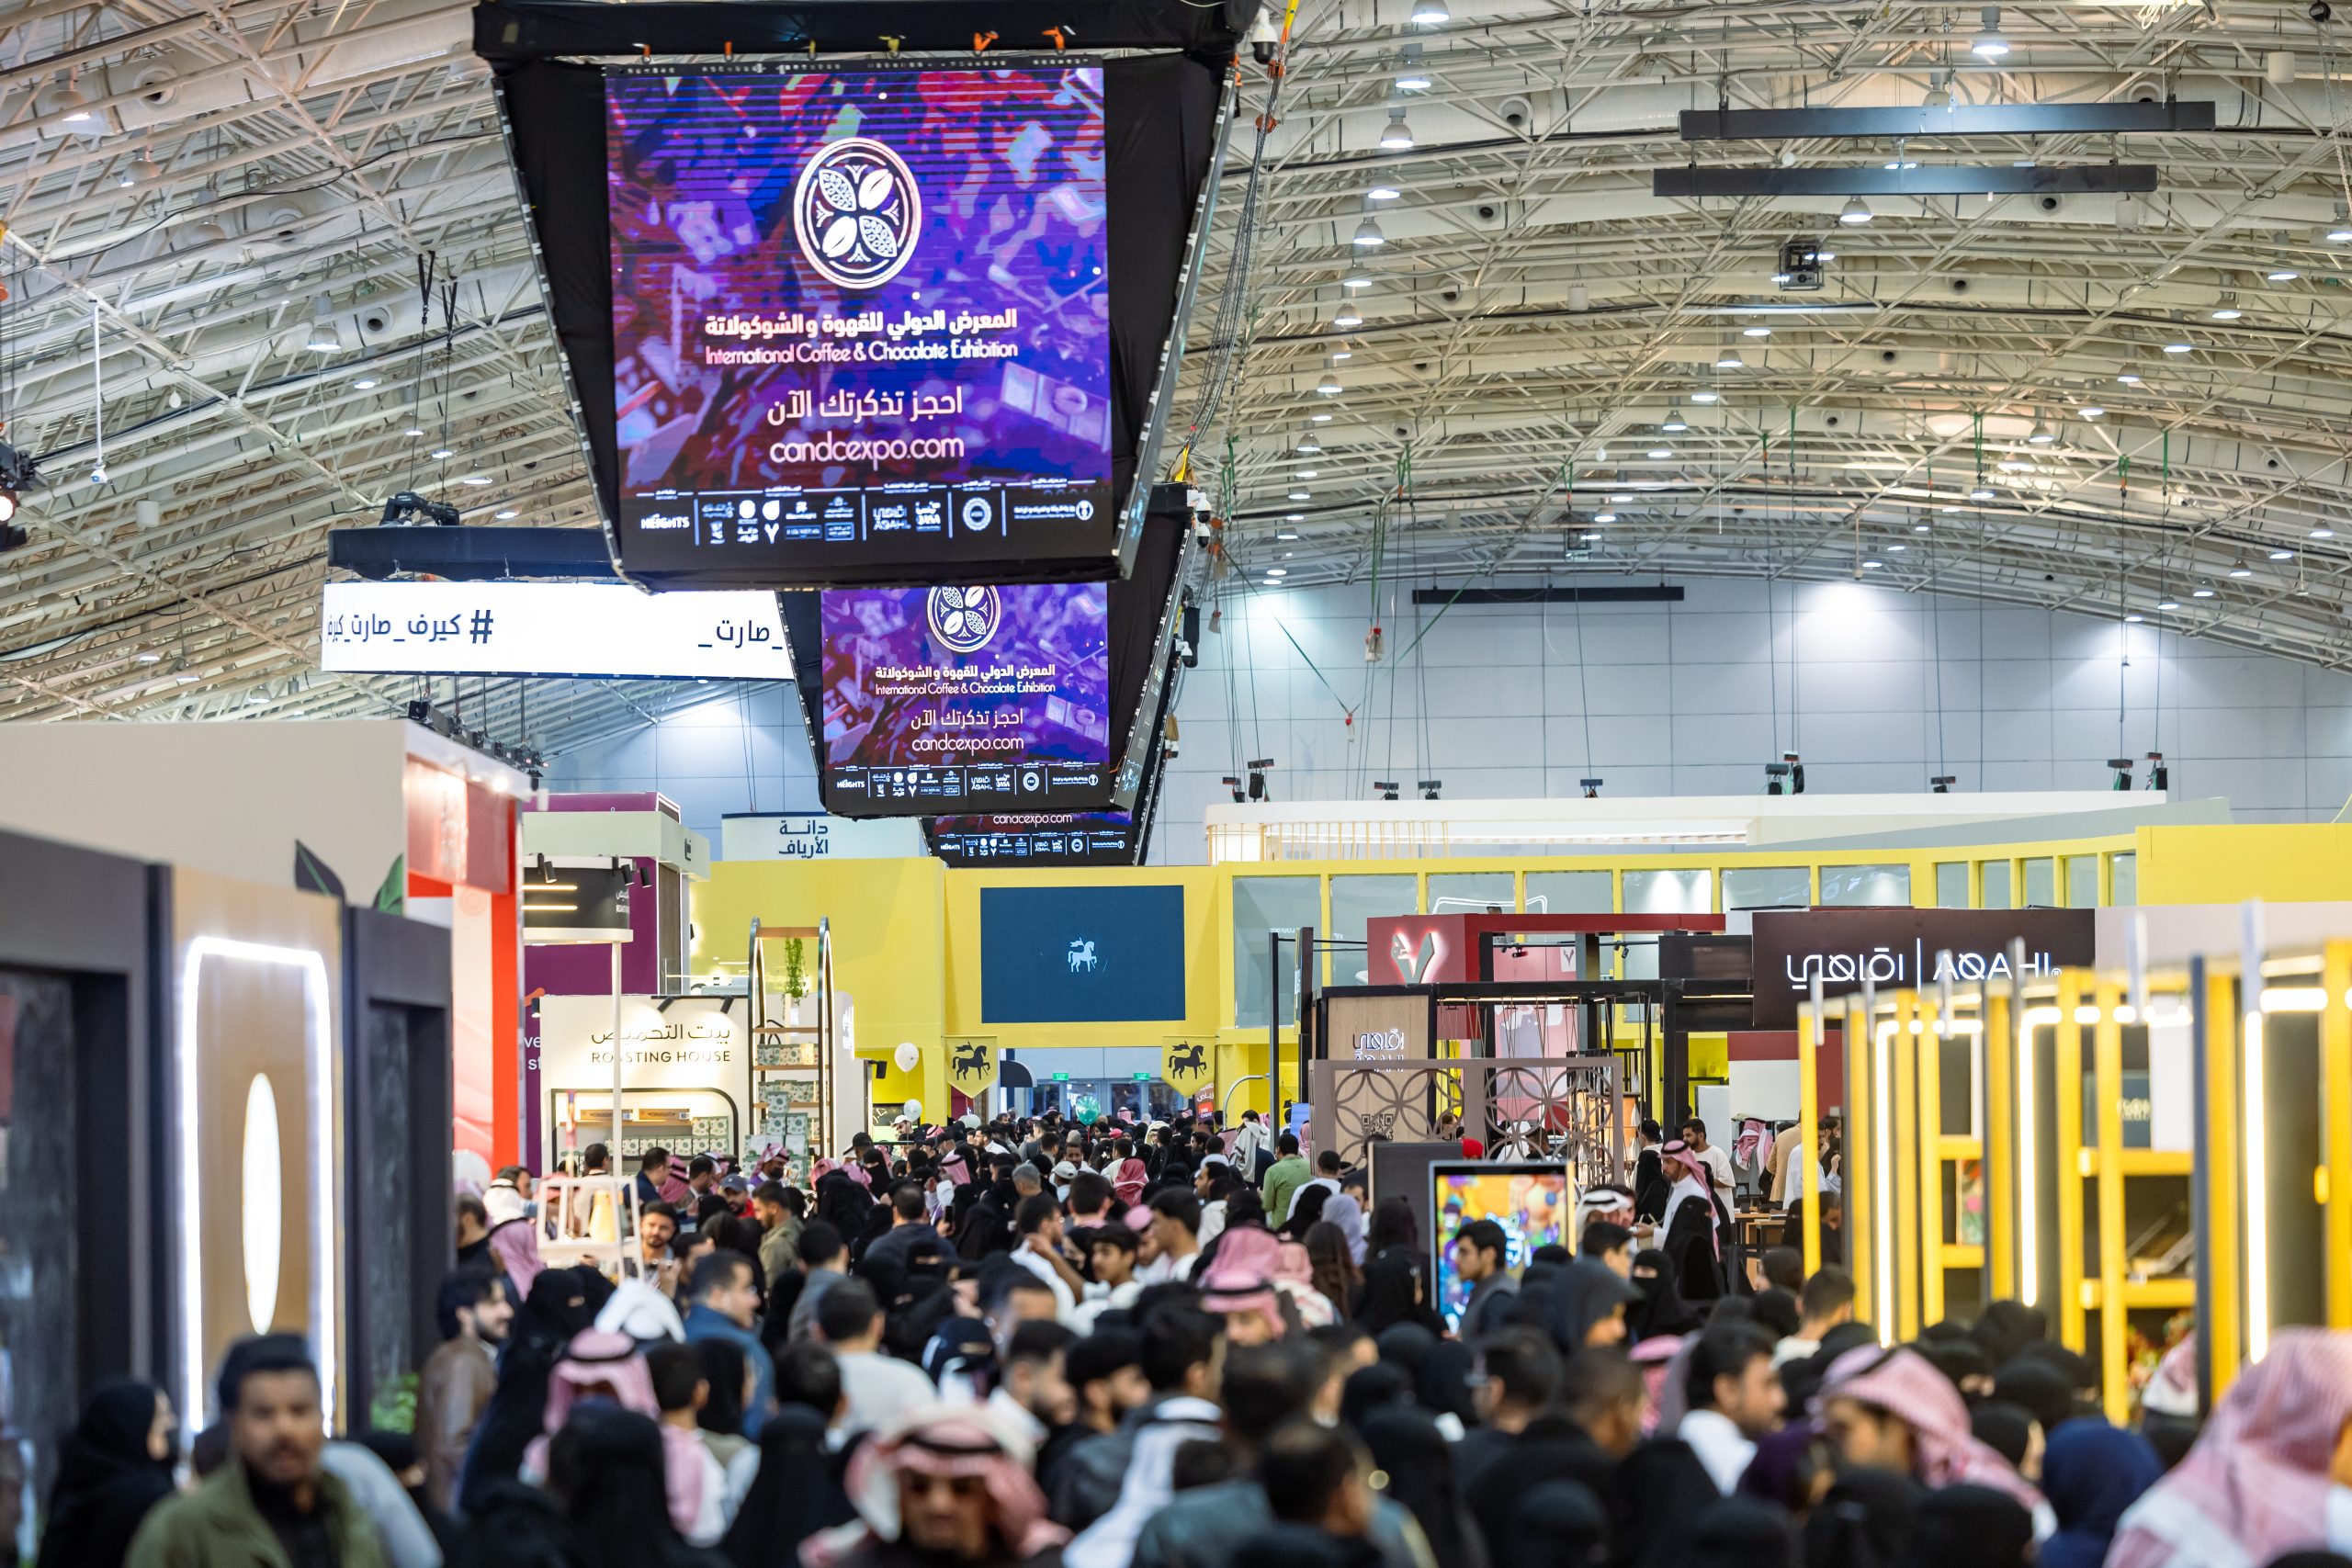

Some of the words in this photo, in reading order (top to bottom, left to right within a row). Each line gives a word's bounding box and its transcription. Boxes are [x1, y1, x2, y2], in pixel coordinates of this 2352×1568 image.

[705, 311, 803, 340] الشوكولاتة
[823, 312, 883, 337] للقهوة
[888, 310, 945, 341] الدولي
[950, 308, 1017, 332] المعرض
[706, 343, 795, 366] International
[797, 343, 851, 363] Coffee
[853, 343, 865, 361] &
[868, 340, 948, 363] Chocolate
[951, 339, 1018, 360] Exhibition
[767, 389, 811, 425] الآن
[820, 388, 905, 424] تذكرتك
[911, 386, 962, 422] احجز
[769, 432, 965, 471] candcexpo.com
[641, 513, 689, 529] HEIGHTS
[876, 666, 932, 681] الشوكولاتة
[943, 665, 978, 679] للقهوة
[980, 665, 1013, 682] الدولي
[1016, 664, 1056, 678] المعرض
[876, 682, 926, 695] International
[928, 682, 958, 694] Coffee
[960, 682, 967, 694] &
[969, 681, 1015, 694] Chocolate
[1016, 681, 1056, 693] Exhibition
[910, 710, 936, 729] الآن
[941, 709, 989, 729] تذكرتك
[993, 708, 1023, 728] احجز
[911, 733, 1024, 756] candcexpo.com
[837, 779, 865, 789] HEIGHTS
[779, 819, 828, 834] دانة
[993, 814, 1072, 828] candcexpo.com
[779, 836, 828, 859] الأرياف
[687, 1024, 730, 1045] بيت
[592, 1051, 672, 1064] ROSTING
[676, 1050, 731, 1063] HOUSE
